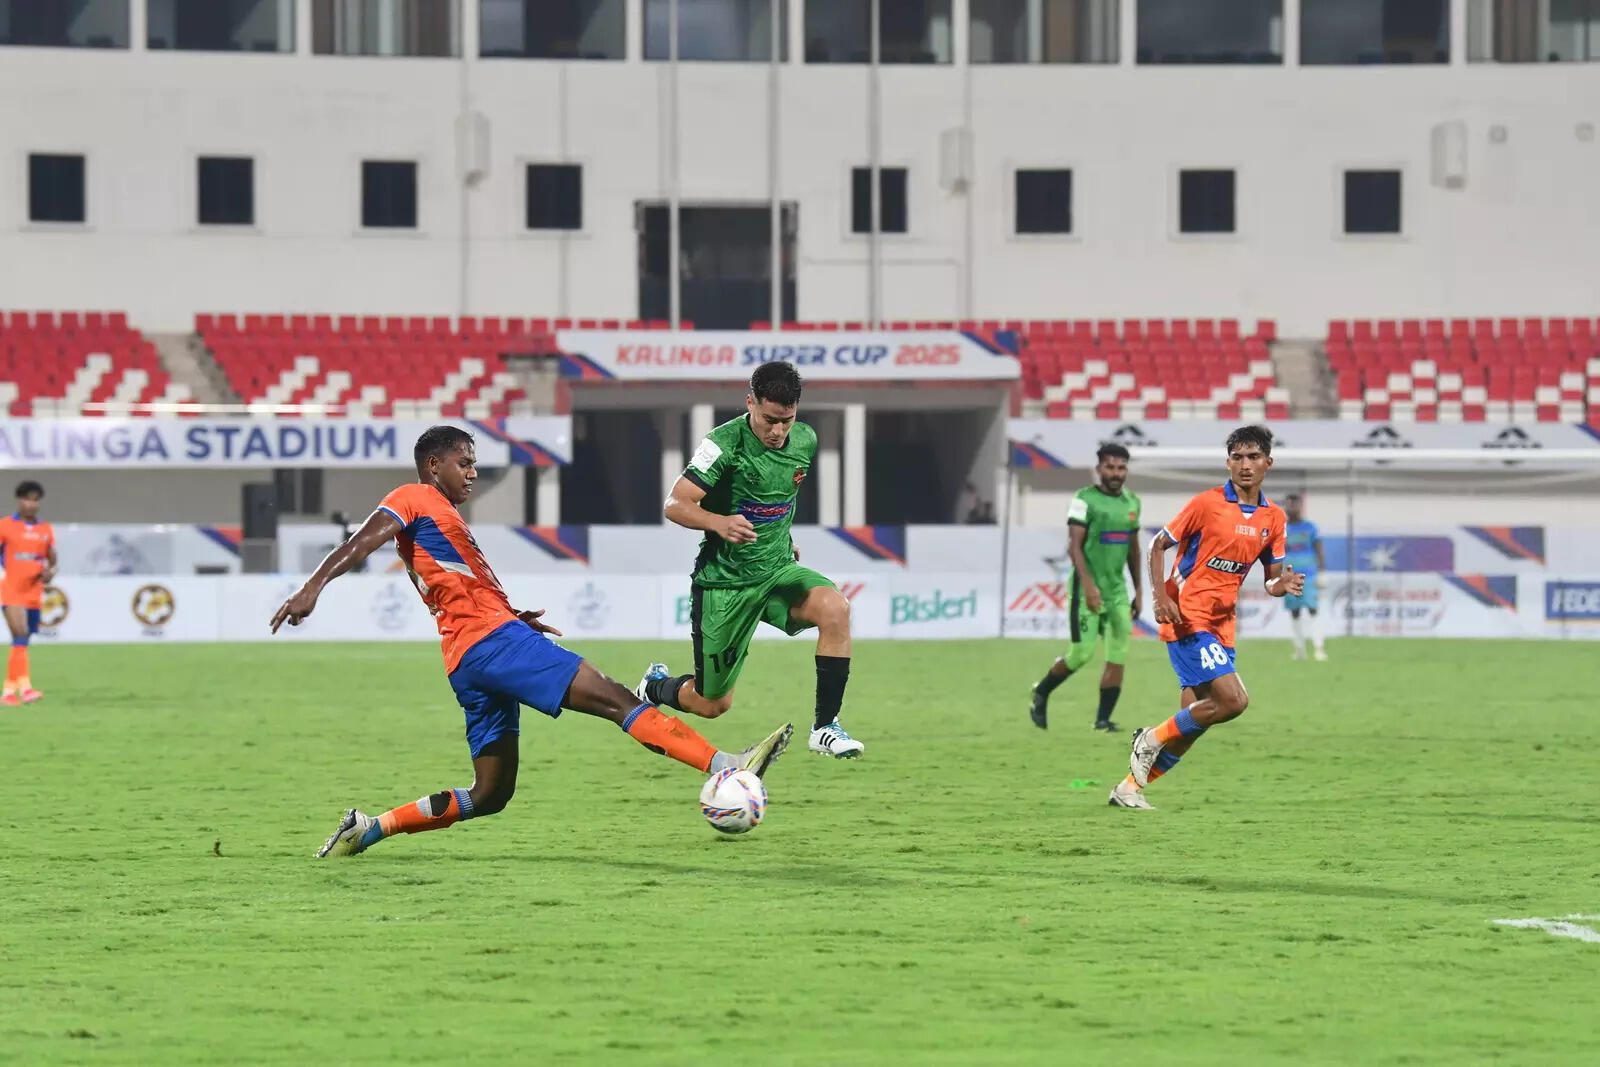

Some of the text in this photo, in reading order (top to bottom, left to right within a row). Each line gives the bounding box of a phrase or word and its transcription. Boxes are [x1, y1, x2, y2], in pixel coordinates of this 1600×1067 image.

[615, 345, 961, 366] KALINGA SUPER CUP 2025
[185, 425, 397, 461] STADIUM
[889, 588, 977, 625] Bisleri
[1200, 643, 1228, 670] 48
